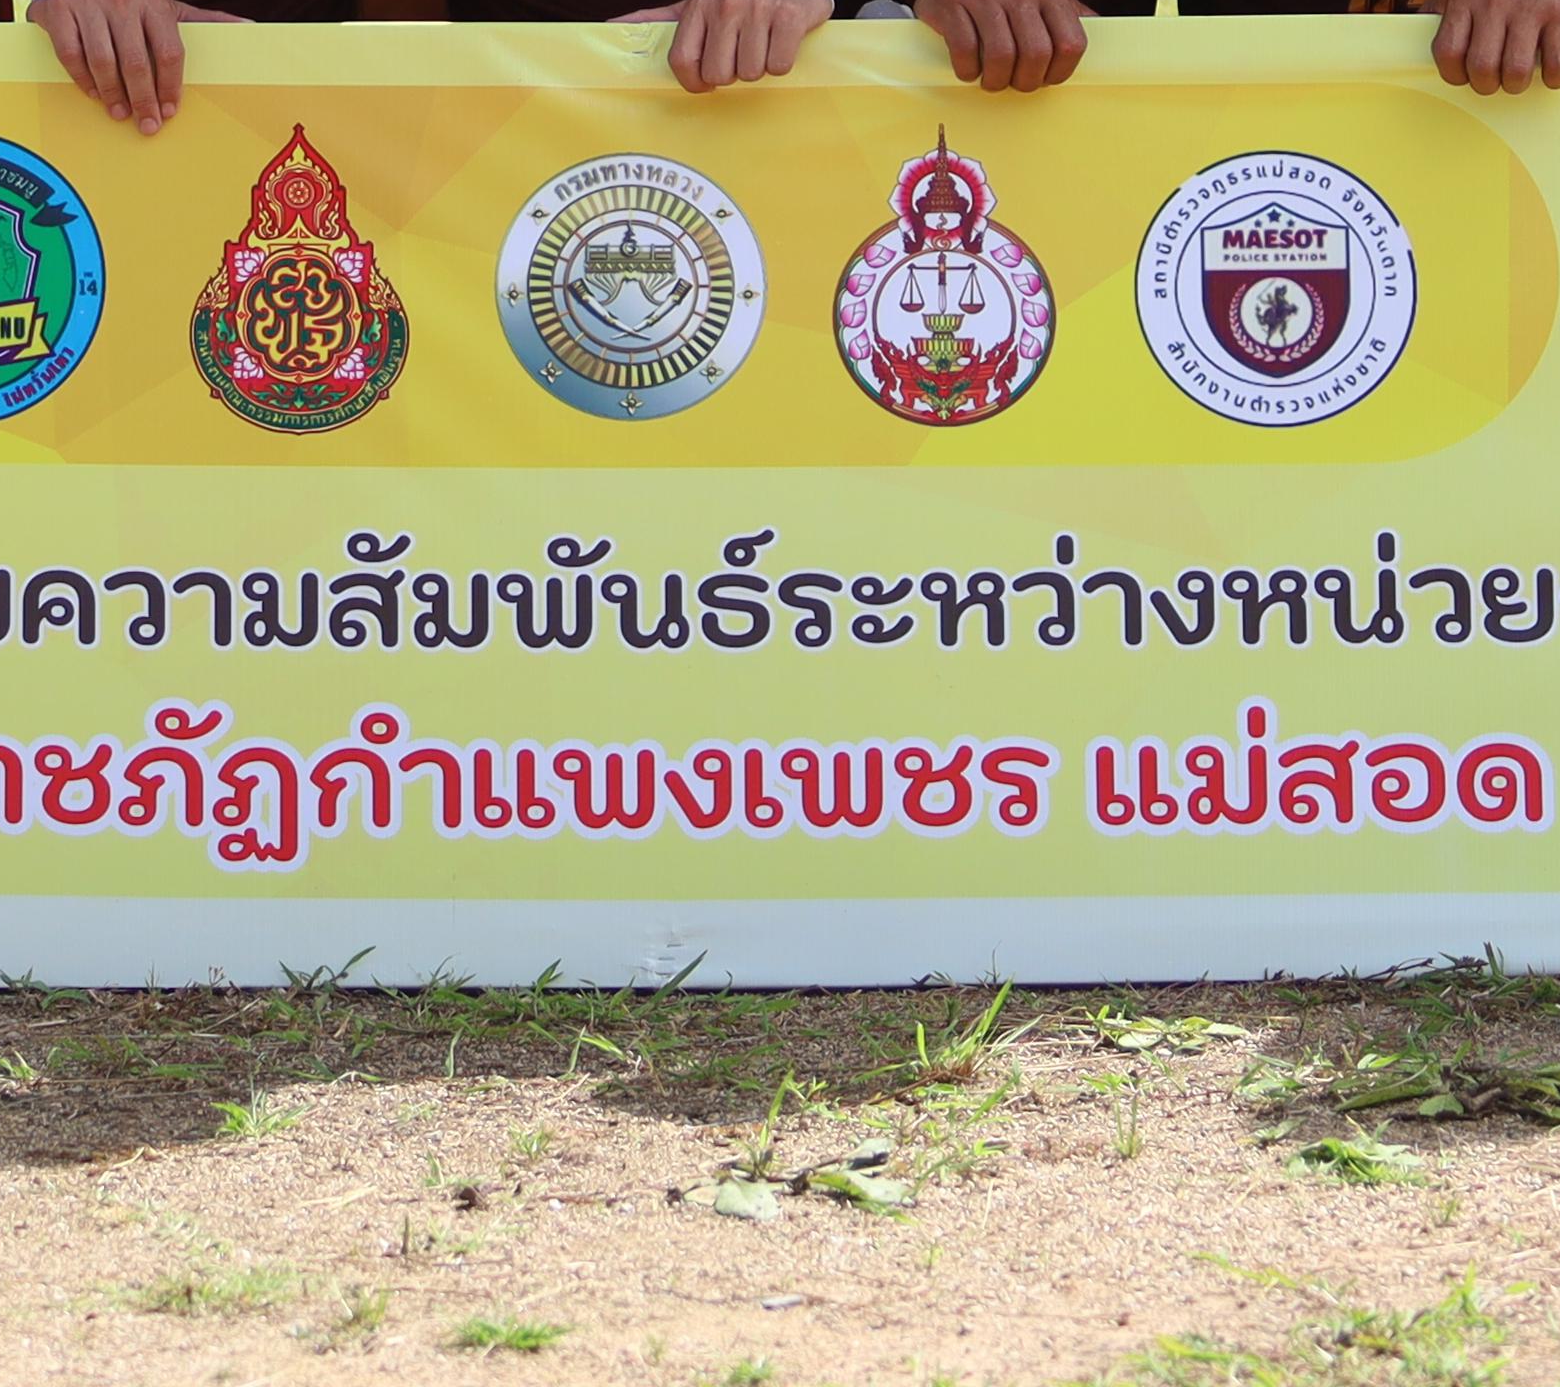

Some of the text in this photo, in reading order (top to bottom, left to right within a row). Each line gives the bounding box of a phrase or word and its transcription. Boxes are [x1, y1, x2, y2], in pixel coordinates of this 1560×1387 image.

[553, 161, 705, 202] กรมทางหลวง
[1153, 159, 1332, 299] สถานีตำรวจภูธรแม่สอด
[1222, 229, 1328, 249] MAESOT
[1223, 253, 1328, 263] POLICE STATION
[78, 278, 98, 296] 14
[1167, 338, 1387, 414] สำนักงานตำรวจแห่งชาติ
[1095, 705, 1544, 827] แม่สอด
